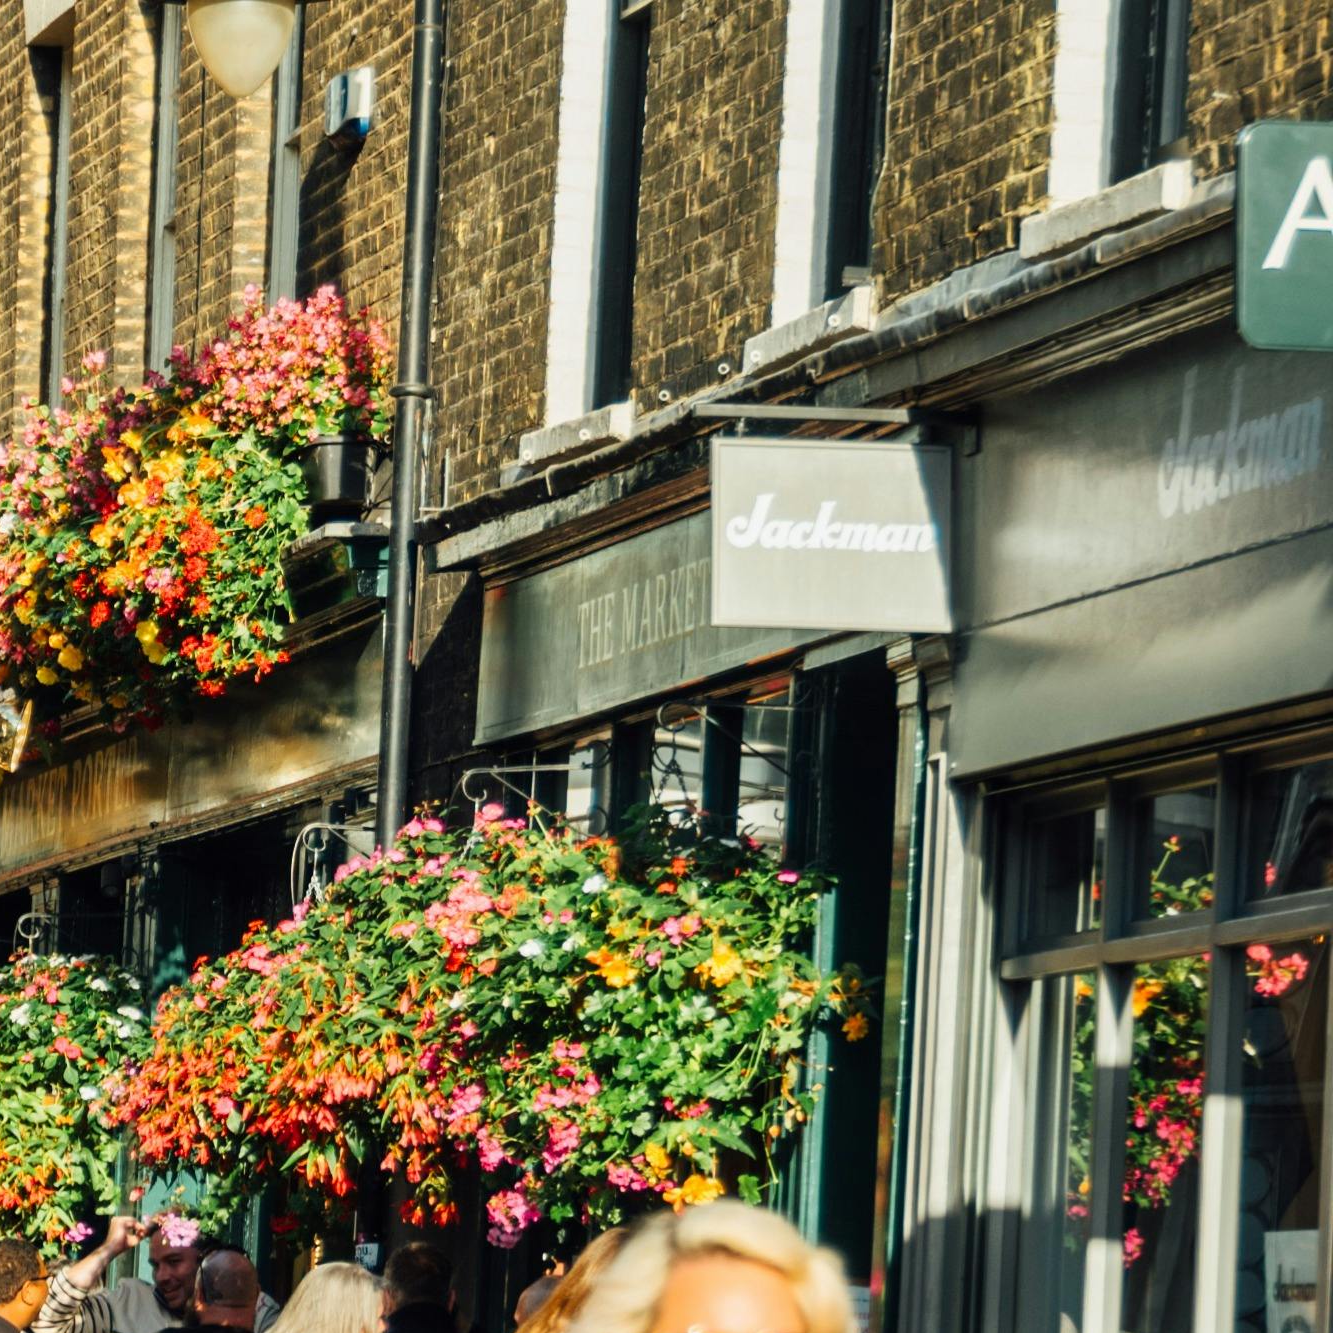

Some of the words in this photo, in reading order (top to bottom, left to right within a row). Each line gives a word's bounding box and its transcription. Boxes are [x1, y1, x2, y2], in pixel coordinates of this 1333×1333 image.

[726, 494, 935, 552] Jackman
[577, 592, 615, 669] THE
[619, 556, 711, 655] MARKET
